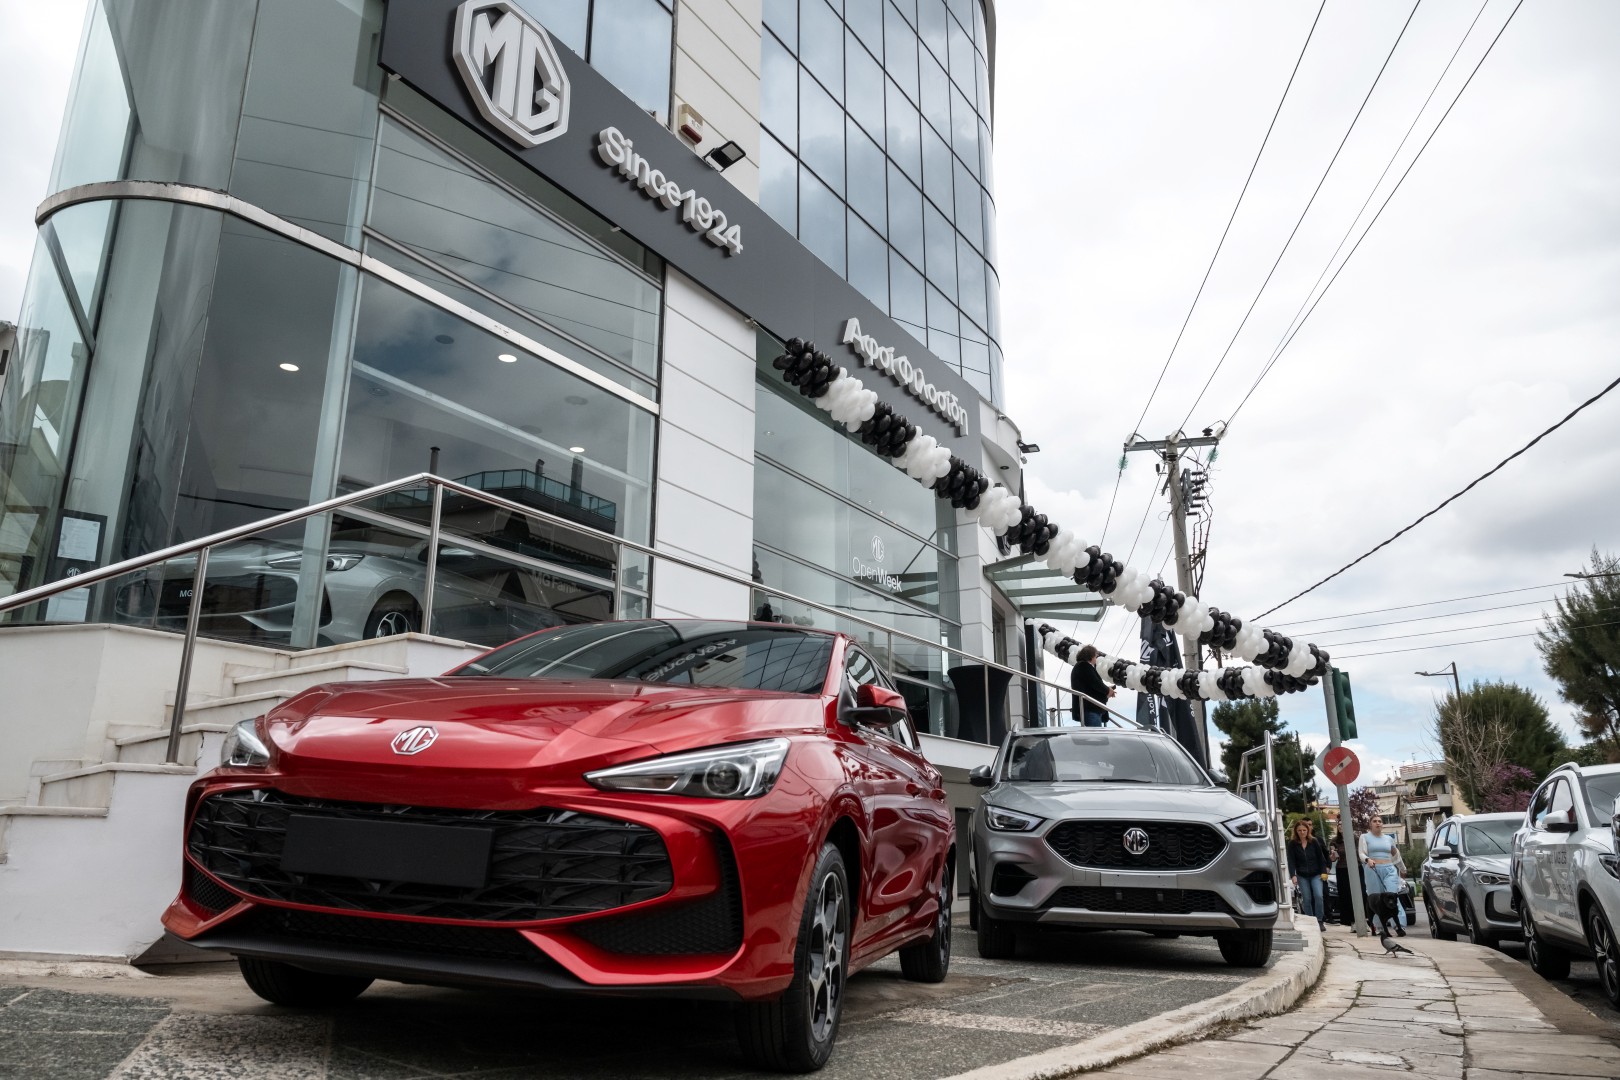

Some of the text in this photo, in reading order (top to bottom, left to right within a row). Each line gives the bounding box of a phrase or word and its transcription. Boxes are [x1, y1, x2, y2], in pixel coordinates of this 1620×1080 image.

[469, 8, 562, 134] MG
[598, 126, 744, 256] Since 1924
[394, 727, 436, 752] MG
[1125, 830, 1147, 851] MG
